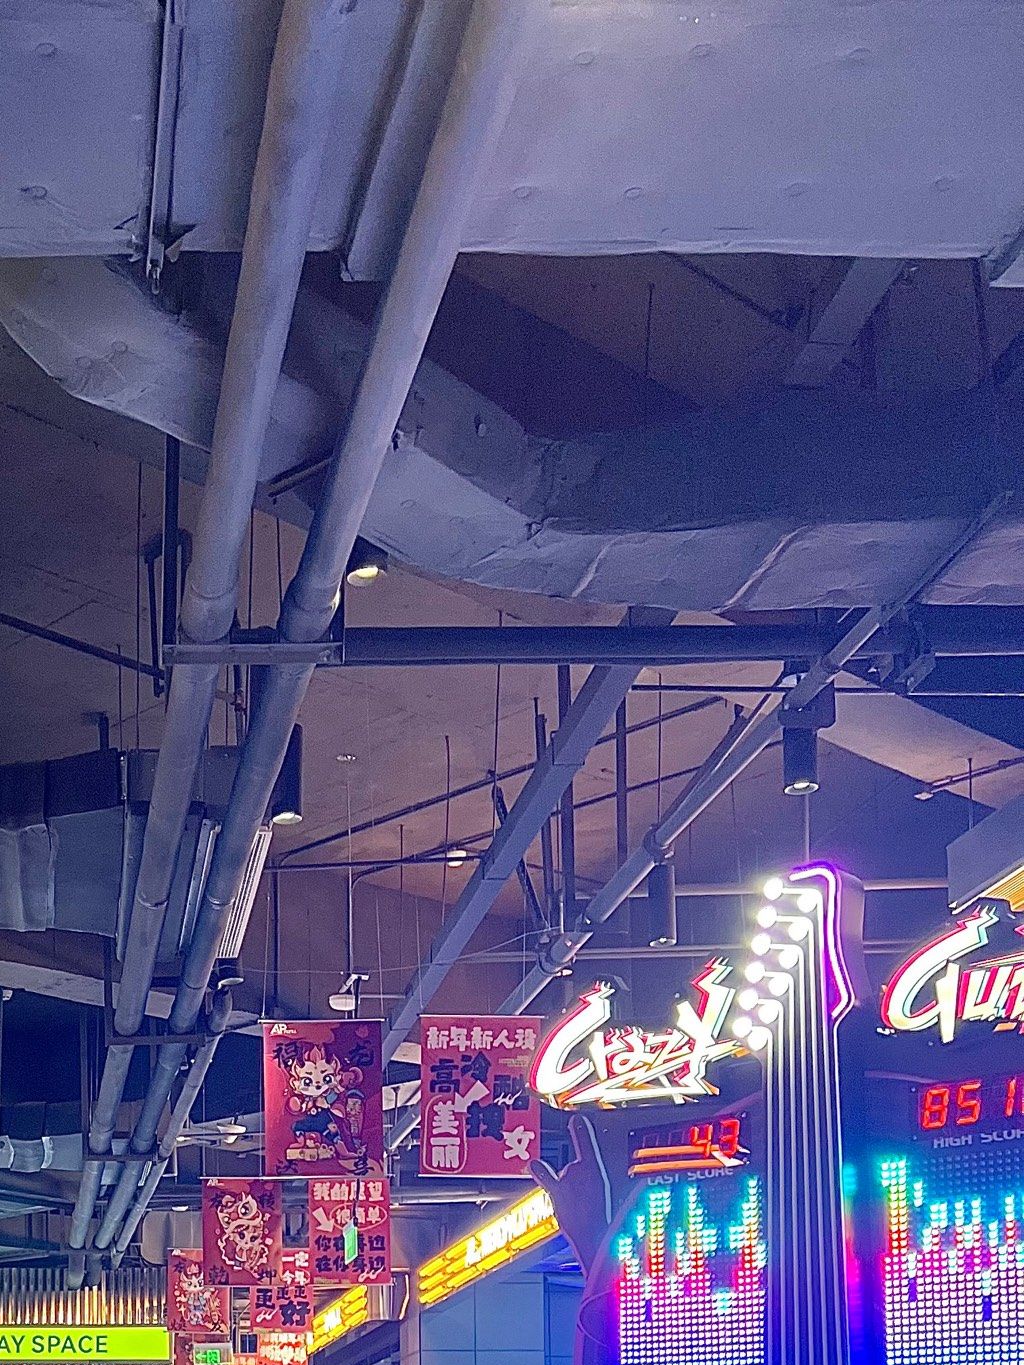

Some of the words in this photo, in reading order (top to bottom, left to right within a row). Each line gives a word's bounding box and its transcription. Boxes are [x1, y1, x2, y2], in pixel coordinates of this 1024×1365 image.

[426, 1026, 537, 1052] 新年新人设
[501, 1125, 536, 1161] 女
[933, 1134, 973, 1149] HIGH
[31, 1334, 109, 1354] SPACE
